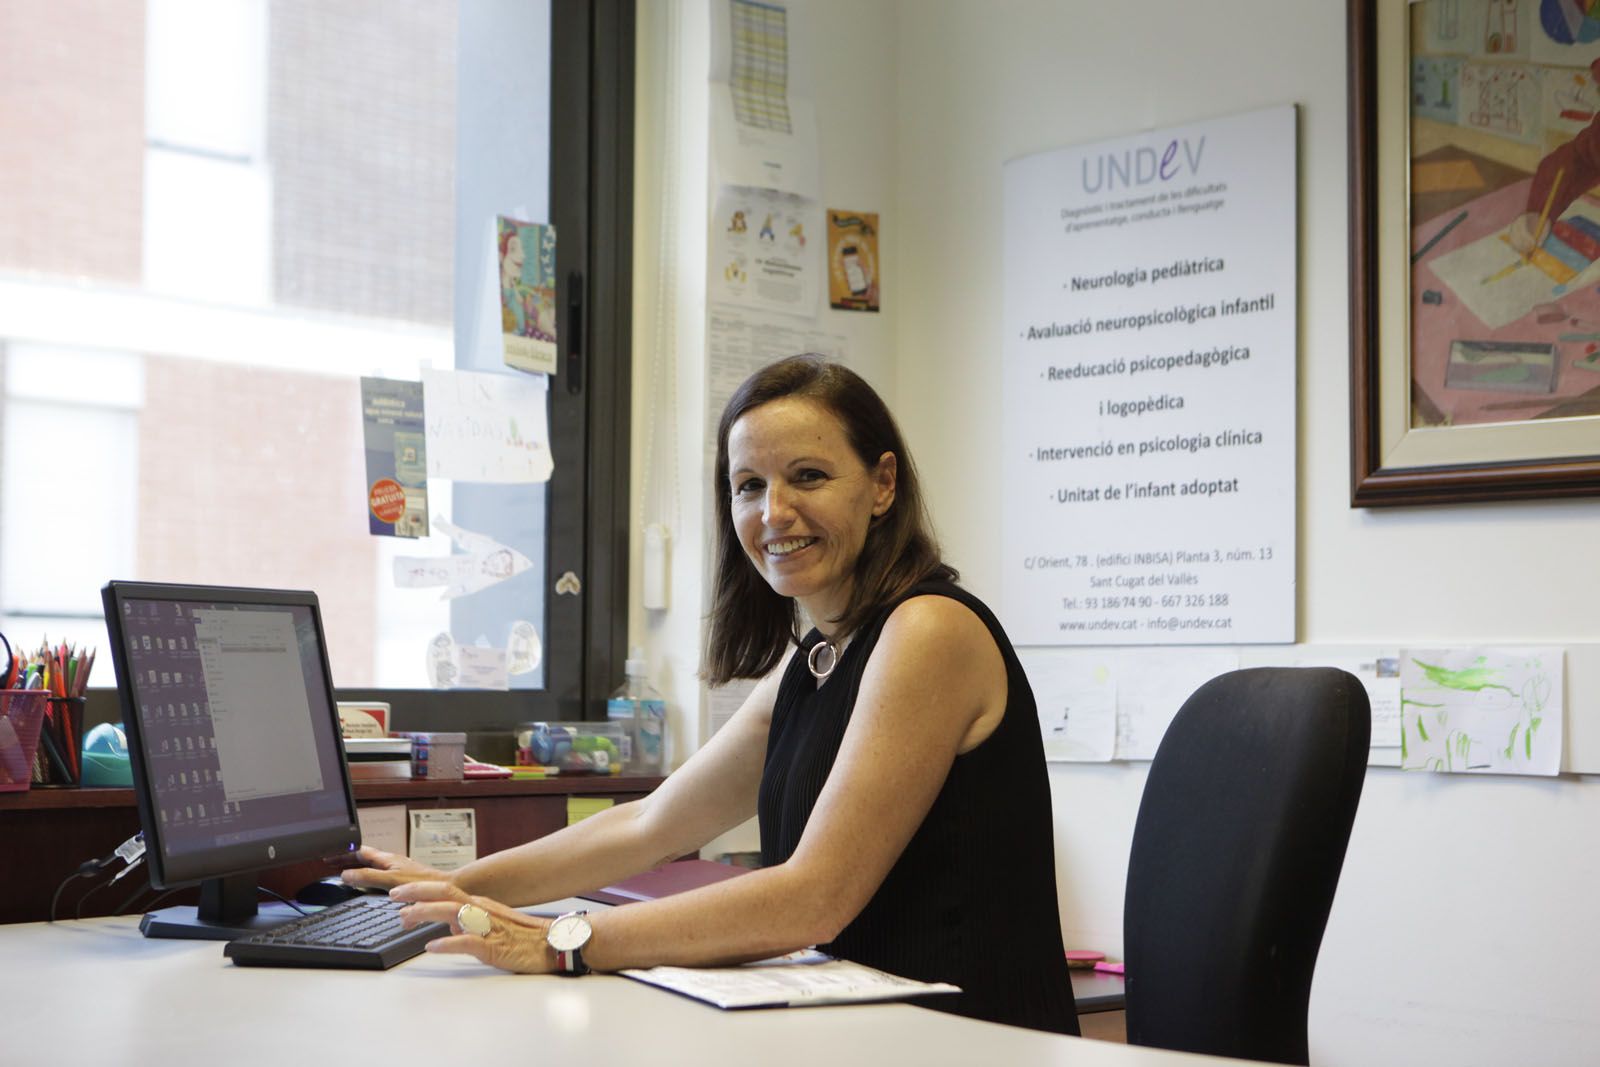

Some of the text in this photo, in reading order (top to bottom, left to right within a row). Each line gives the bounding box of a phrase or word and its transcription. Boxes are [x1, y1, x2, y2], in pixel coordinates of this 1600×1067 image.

[1158, 192, 1169, 202] de
[1171, 191, 1182, 200] les
[1131, 208, 1171, 222] conducta
[1071, 257, 1224, 292] Neurologia pediàtrica
[1027, 294, 1274, 340] Avaluació neuropsicològica infantil
[1048, 346, 1250, 382] Reeducació psicopedagògica
[1099, 394, 1184, 418] i logopèdica
[1037, 428, 1262, 462] Intervenció en psicologia clínica
[1058, 476, 1238, 504] Unitat de l'infant adoptat
[1024, 547, 1273, 570] C/ Orient, 78 (edifici INBISA) Planta 3, núm. 13
[1090, 573, 1198, 590] Sant Cugat del Vallès
[1085, 597, 1098, 609] 93
[1102, 596, 1120, 608] 186
[1122, 596, 1137, 608] 74
[1138, 596, 1152, 608] 90
[1161, 595, 1181, 607] 667
[1184, 594, 1205, 606] 326
[1208, 594, 1229, 606] 188
[1060, 618, 1136, 631] www.undev.cat
[1147, 616, 1232, 630] info@undev.cat
